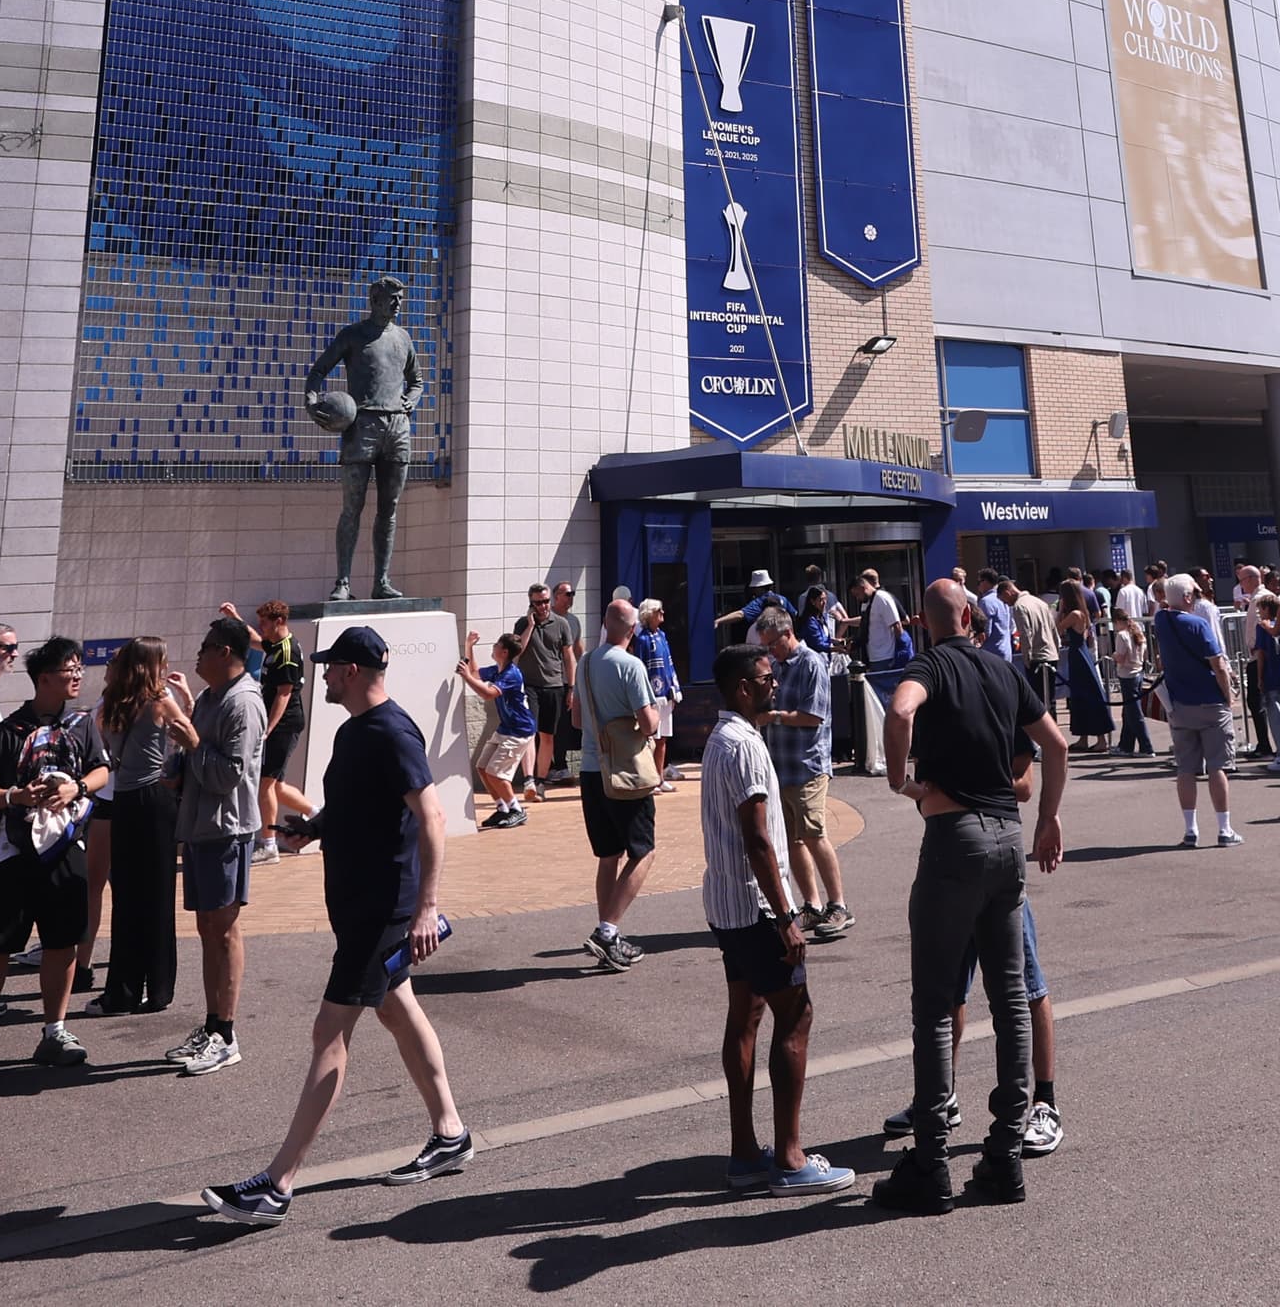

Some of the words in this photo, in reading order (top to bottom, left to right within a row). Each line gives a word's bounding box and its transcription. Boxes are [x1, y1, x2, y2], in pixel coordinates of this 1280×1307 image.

[1124, 31, 1223, 81] CHAMPIONS
[711, 121, 754, 134] WOMEN'S
[703, 130, 739, 143] LEAGUE
[740, 135, 761, 146] CUP
[742, 153, 758, 161] 2025
[726, 302, 746, 312] FIFA
[726, 324, 747, 333] CUP
[730, 345, 744, 353] 2021
[842, 423, 932, 470] MILLENNIUM
[881, 469, 922, 492] RECEPTION
[981, 502, 1049, 520] Westview
